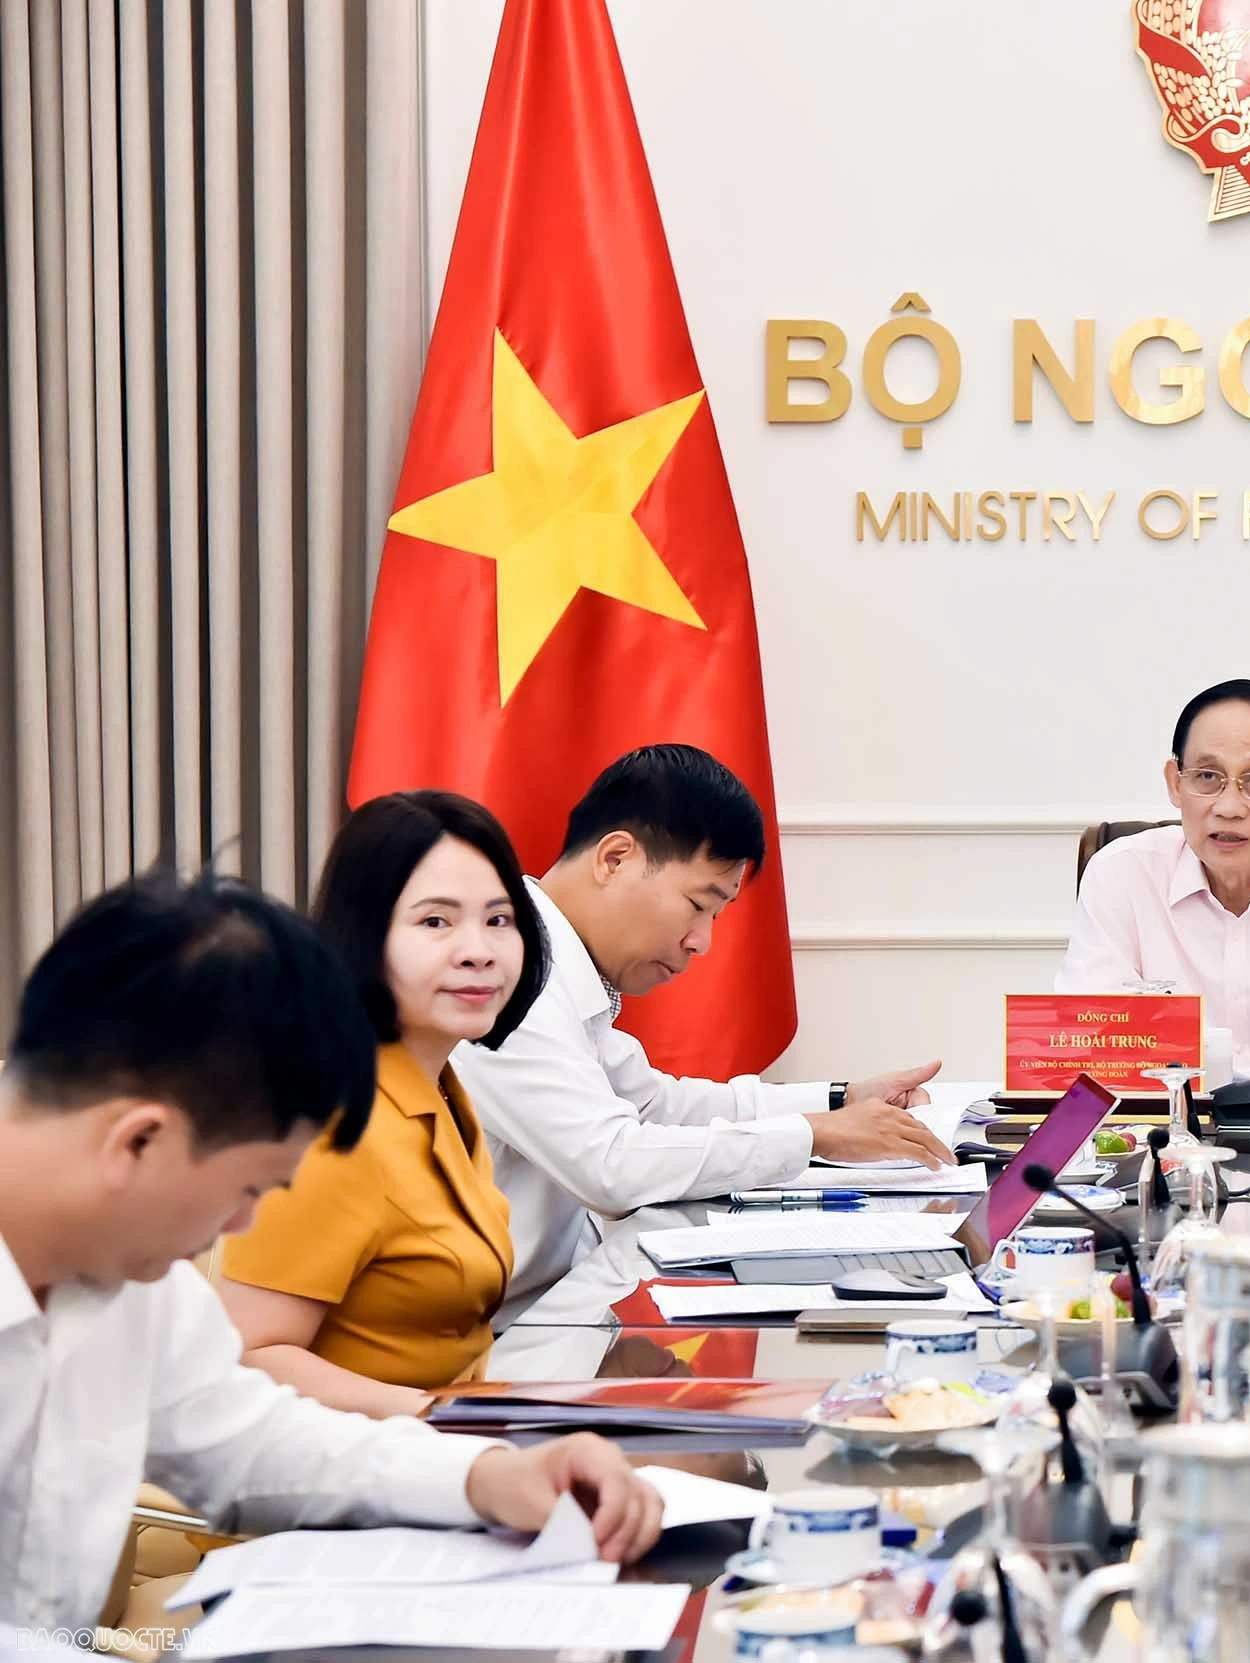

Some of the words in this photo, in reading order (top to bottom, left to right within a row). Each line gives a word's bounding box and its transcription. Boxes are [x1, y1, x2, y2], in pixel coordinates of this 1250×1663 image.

[765, 292, 962, 450] BỘ
[856, 490, 1116, 542] MINISTRY
[1137, 488, 1218, 541] OF
[1110, 1011, 1129, 1023] CHÍ
[1050, 1031, 1067, 1048] LÊ
[1071, 1031, 1106, 1048] HOÀI
[1110, 1034, 1157, 1048] TRUNG
